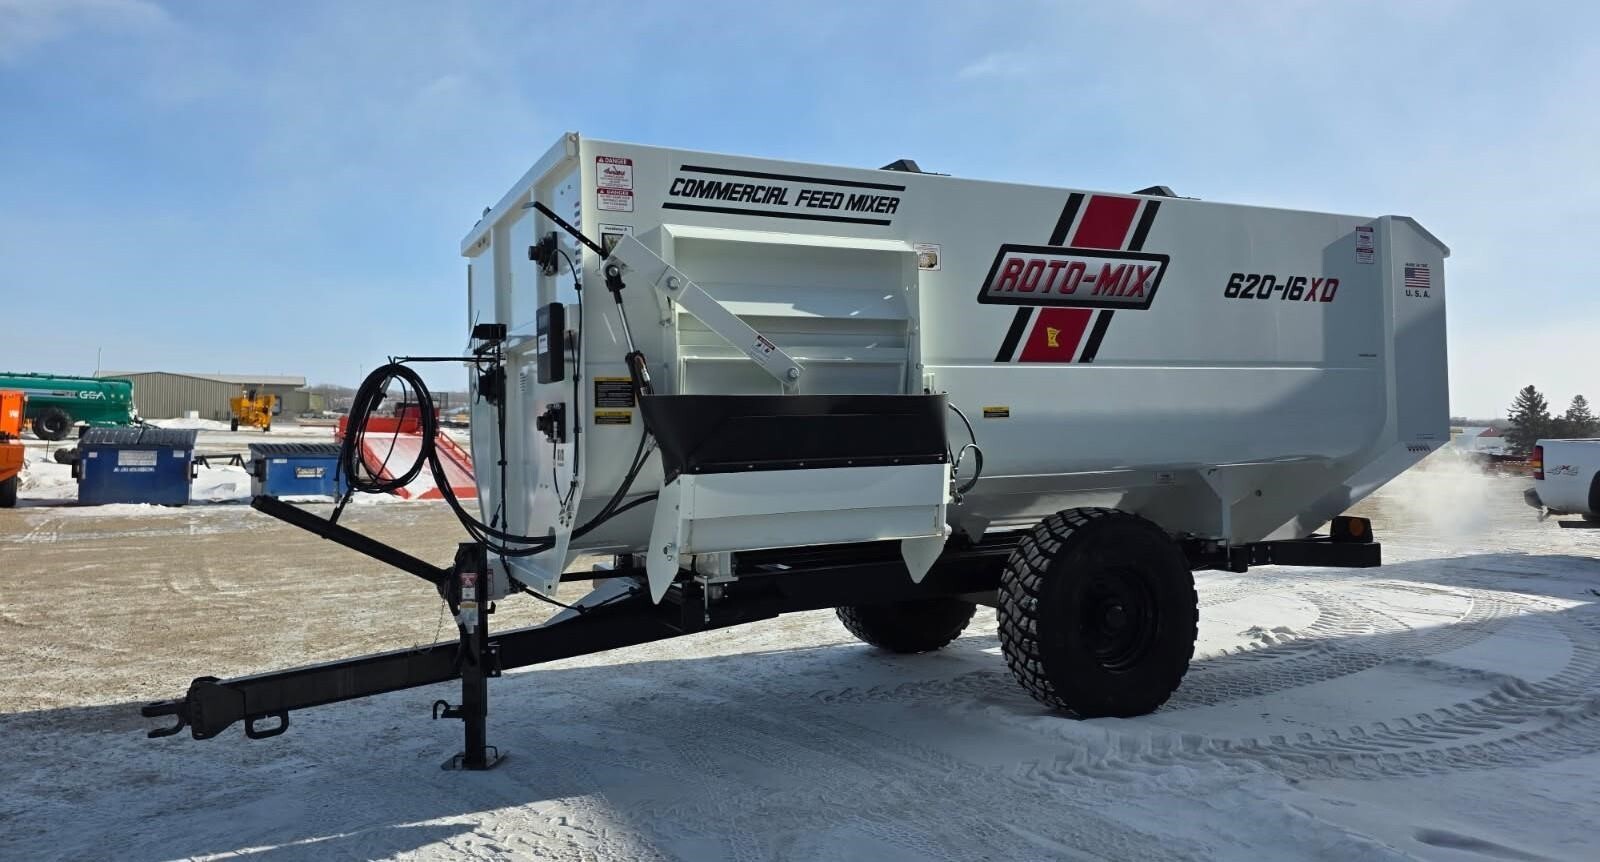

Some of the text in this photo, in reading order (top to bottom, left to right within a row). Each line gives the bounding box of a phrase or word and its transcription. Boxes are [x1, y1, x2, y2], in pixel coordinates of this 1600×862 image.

[669, 177, 900, 214] COMMERCIAL FEED MIXER
[994, 257, 1157, 297] ROTO-MIX
[1224, 272, 1340, 302] 620-16XD
[79, 391, 106, 400] GEA
